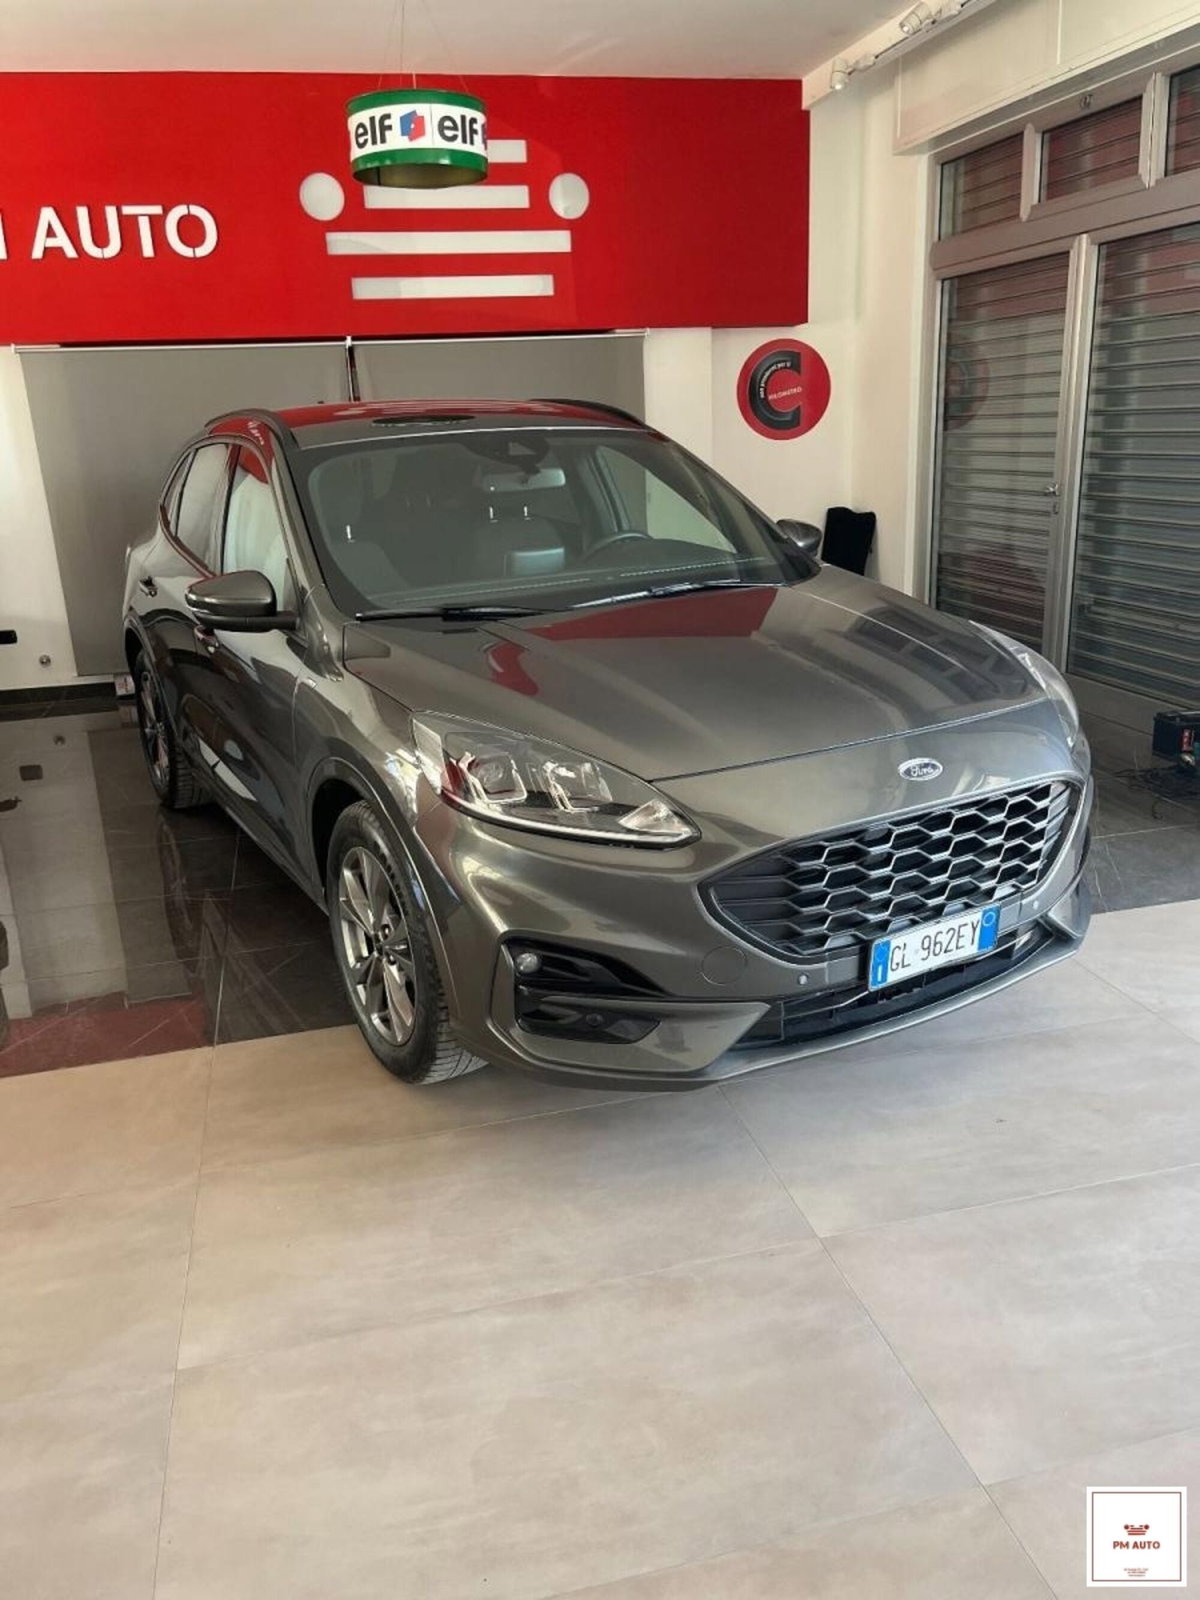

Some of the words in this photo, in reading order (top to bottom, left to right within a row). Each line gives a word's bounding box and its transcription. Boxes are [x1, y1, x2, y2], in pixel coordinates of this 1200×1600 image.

[354, 113, 393, 149] elf
[437, 114, 478, 146] elf
[31, 204, 218, 259] AUTO
